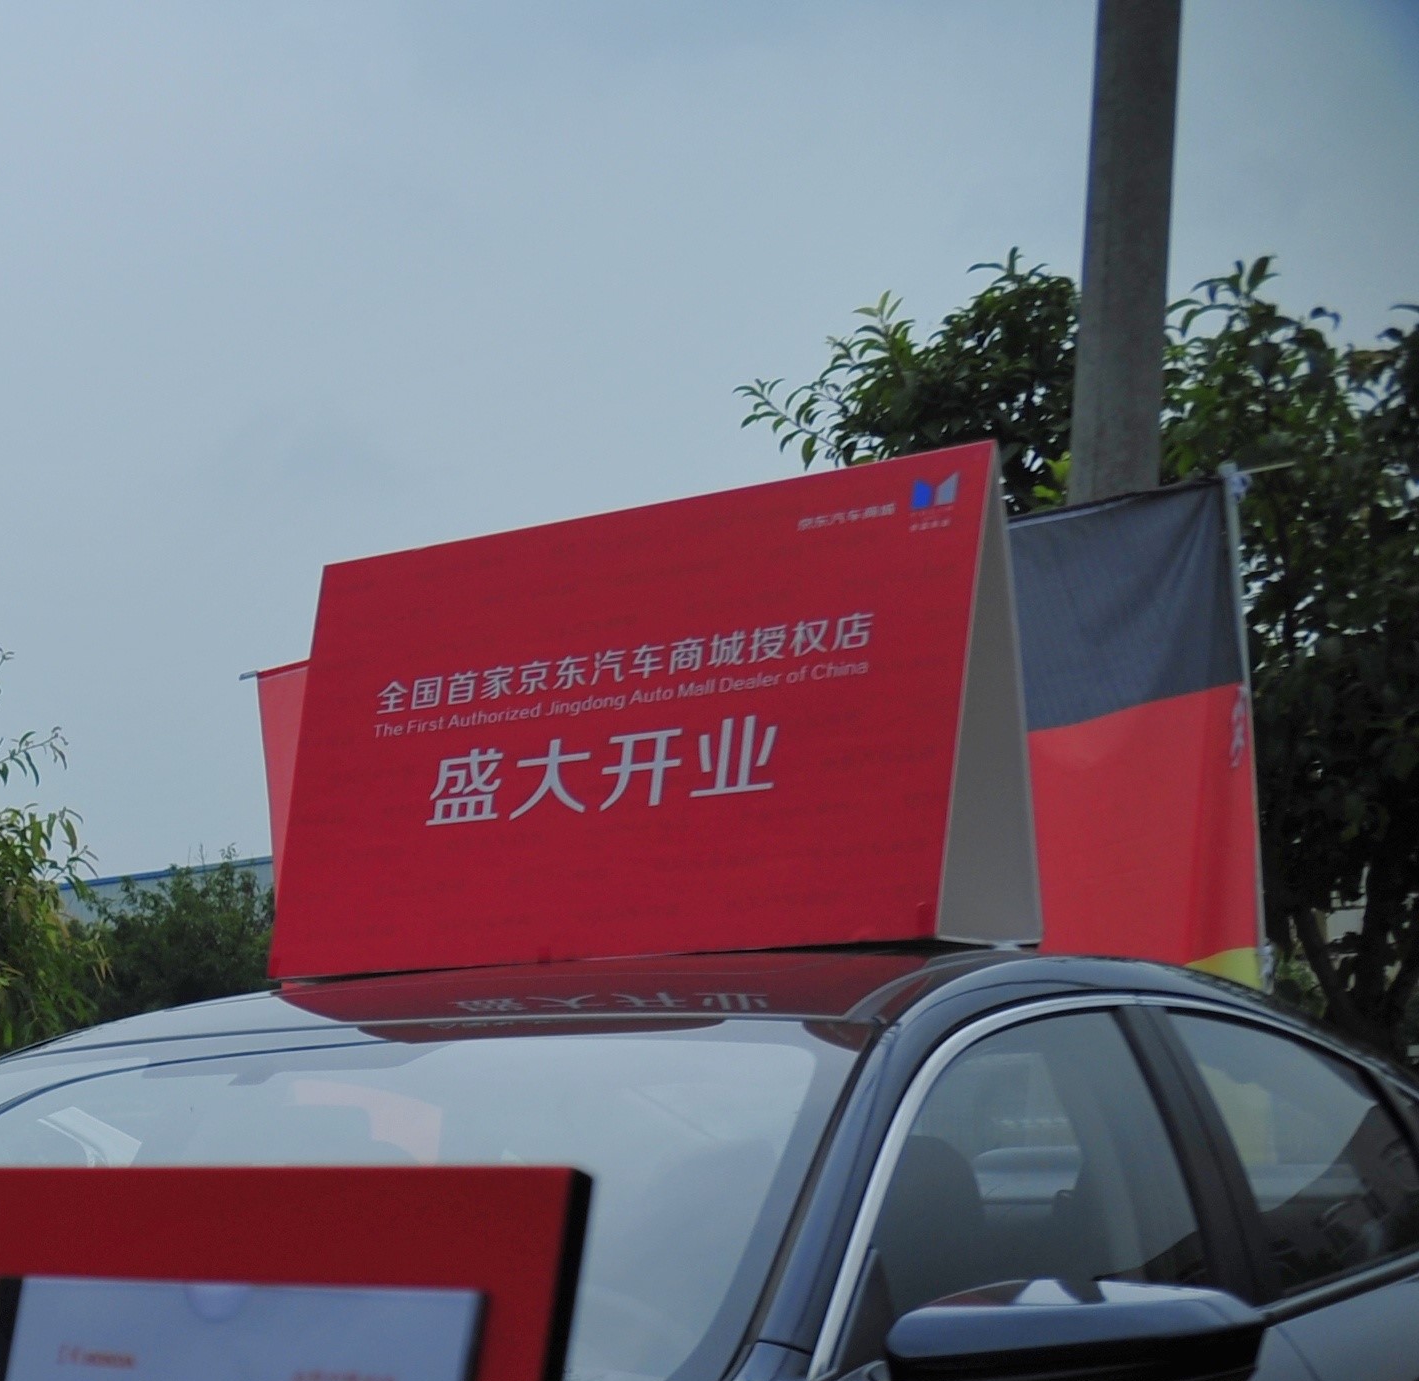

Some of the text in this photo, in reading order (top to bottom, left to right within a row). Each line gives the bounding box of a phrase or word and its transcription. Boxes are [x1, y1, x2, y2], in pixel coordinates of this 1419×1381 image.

[374, 661, 869, 738] The First Authorized Jingdong Auto Mall Dealer of China
[376, 612, 874, 714] 全国首家京东汽车商城授权店
[425, 714, 779, 826] 盛大开业
